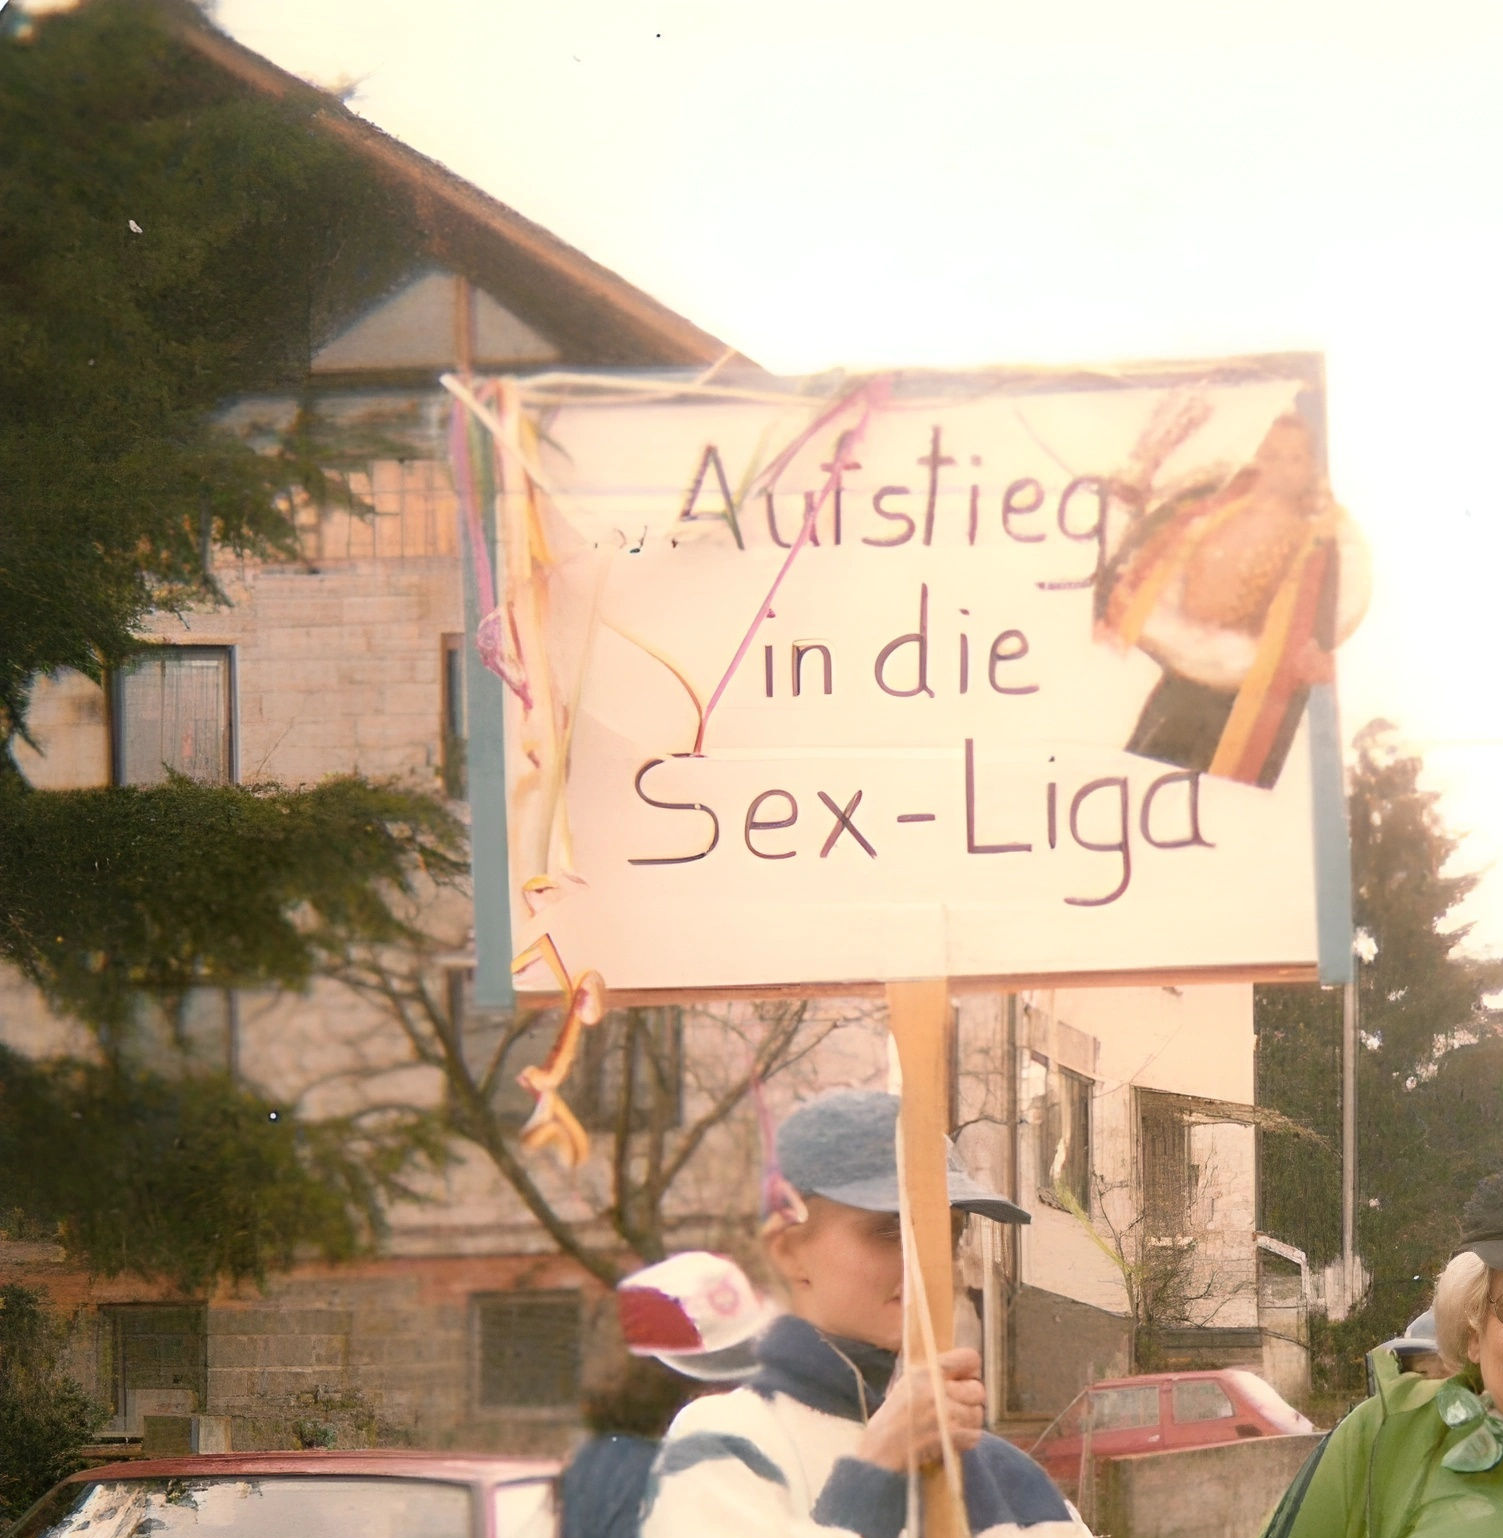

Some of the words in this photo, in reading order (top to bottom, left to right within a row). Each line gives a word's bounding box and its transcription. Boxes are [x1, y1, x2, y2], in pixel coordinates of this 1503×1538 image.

[681, 424, 1108, 590] Aufstieg
[764, 607, 833, 698] in
[873, 582, 1040, 698] die
